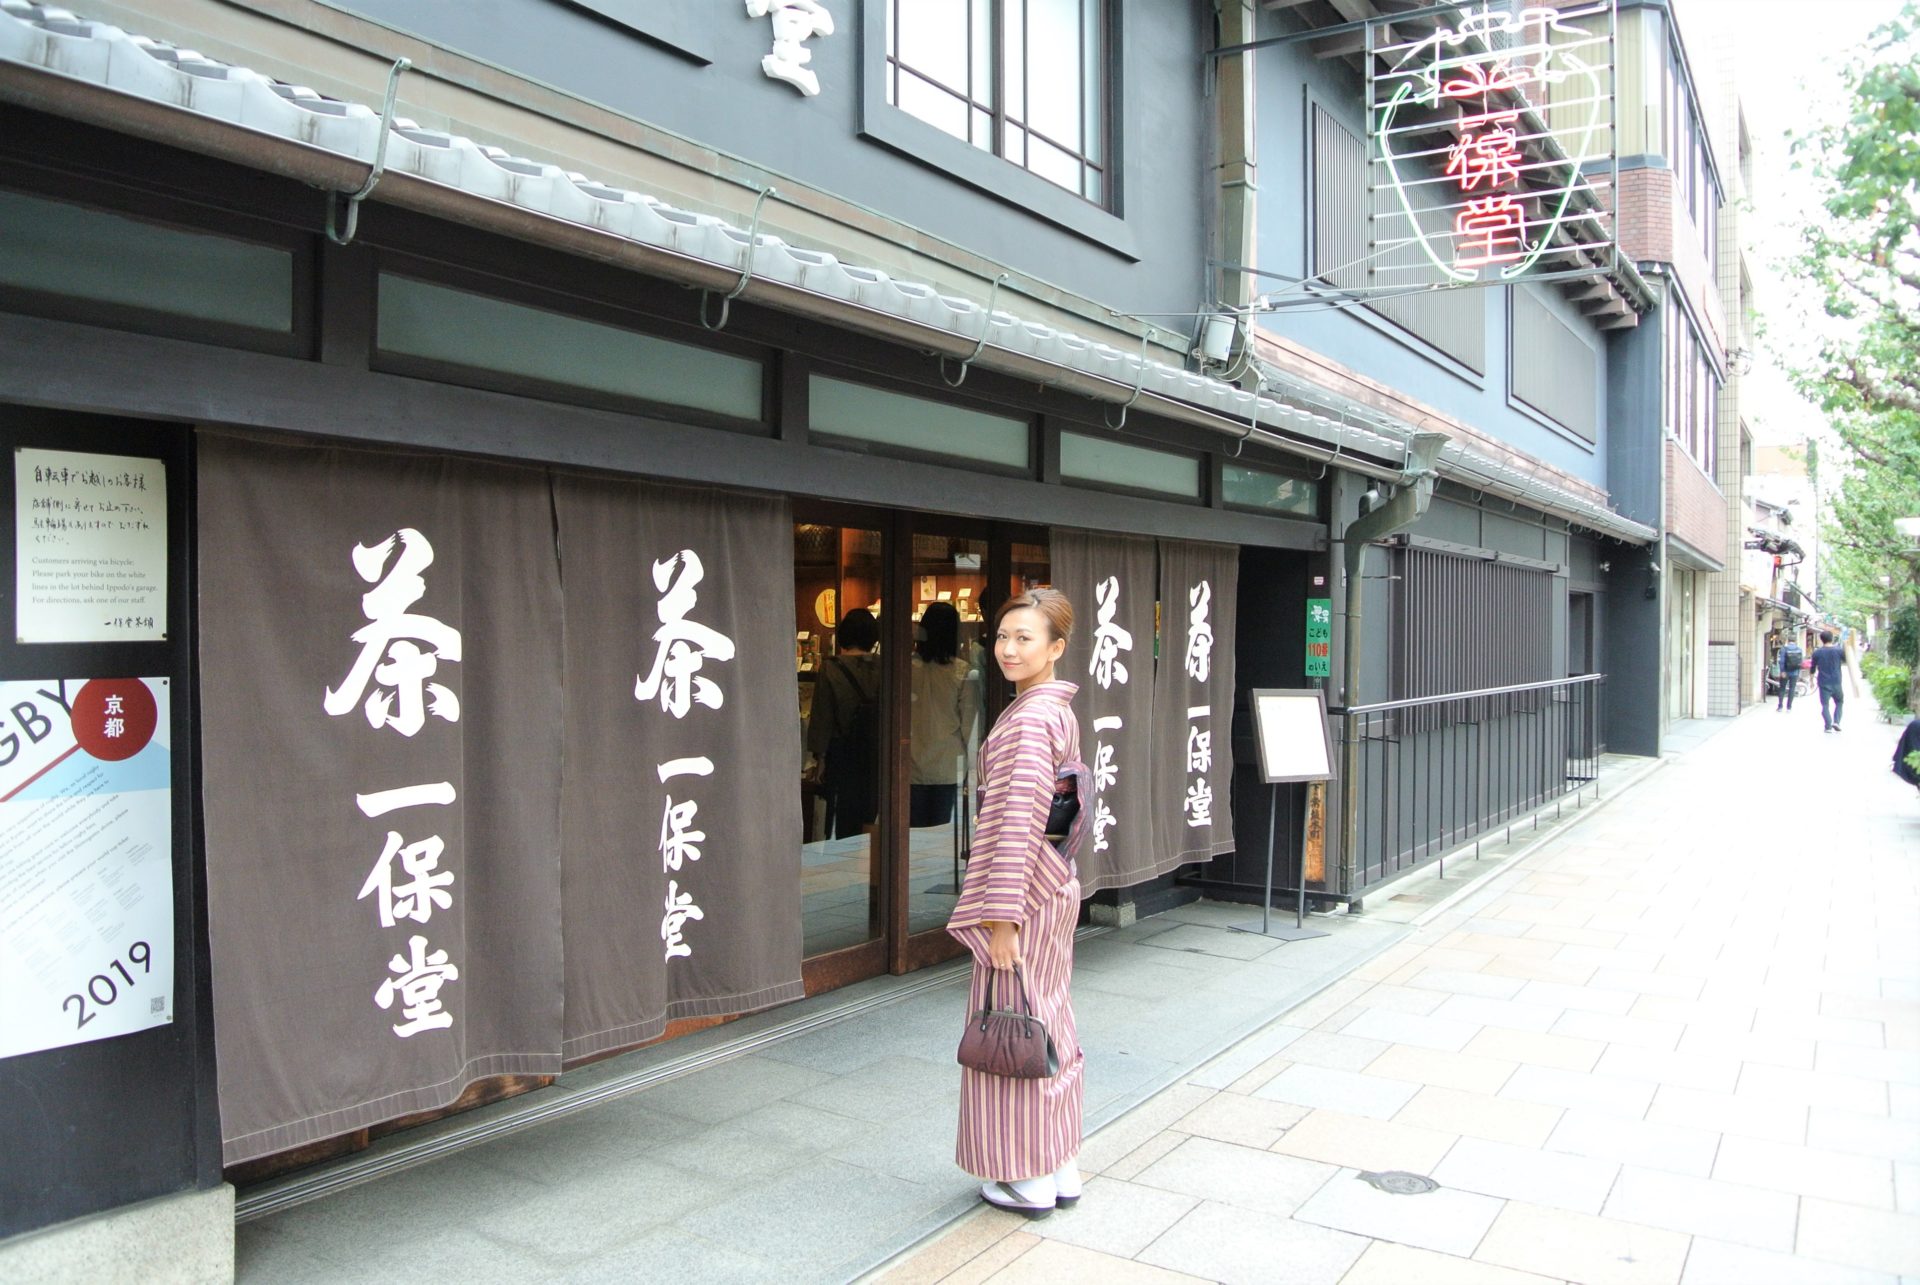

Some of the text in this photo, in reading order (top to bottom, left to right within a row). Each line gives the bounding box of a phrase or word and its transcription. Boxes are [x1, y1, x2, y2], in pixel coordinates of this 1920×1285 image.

[71, 558, 97, 567] arriving
[55, 570, 71, 579] park
[91, 570, 105, 578] bike
[128, 571, 146, 579] white
[32, 583, 48, 591] lines
[59, 583, 69, 591] the
[71, 583, 80, 591] lot
[81, 583, 105, 591] behind
[106, 584, 135, 592] Ippodo's
[1309, 628, 1328, 638] こども
[1308, 643, 1328, 657] 110番
[1308, 661, 1327, 671] のいえ
[104, 694, 125, 738] 京都
[62, 940, 152, 1031] 2019
